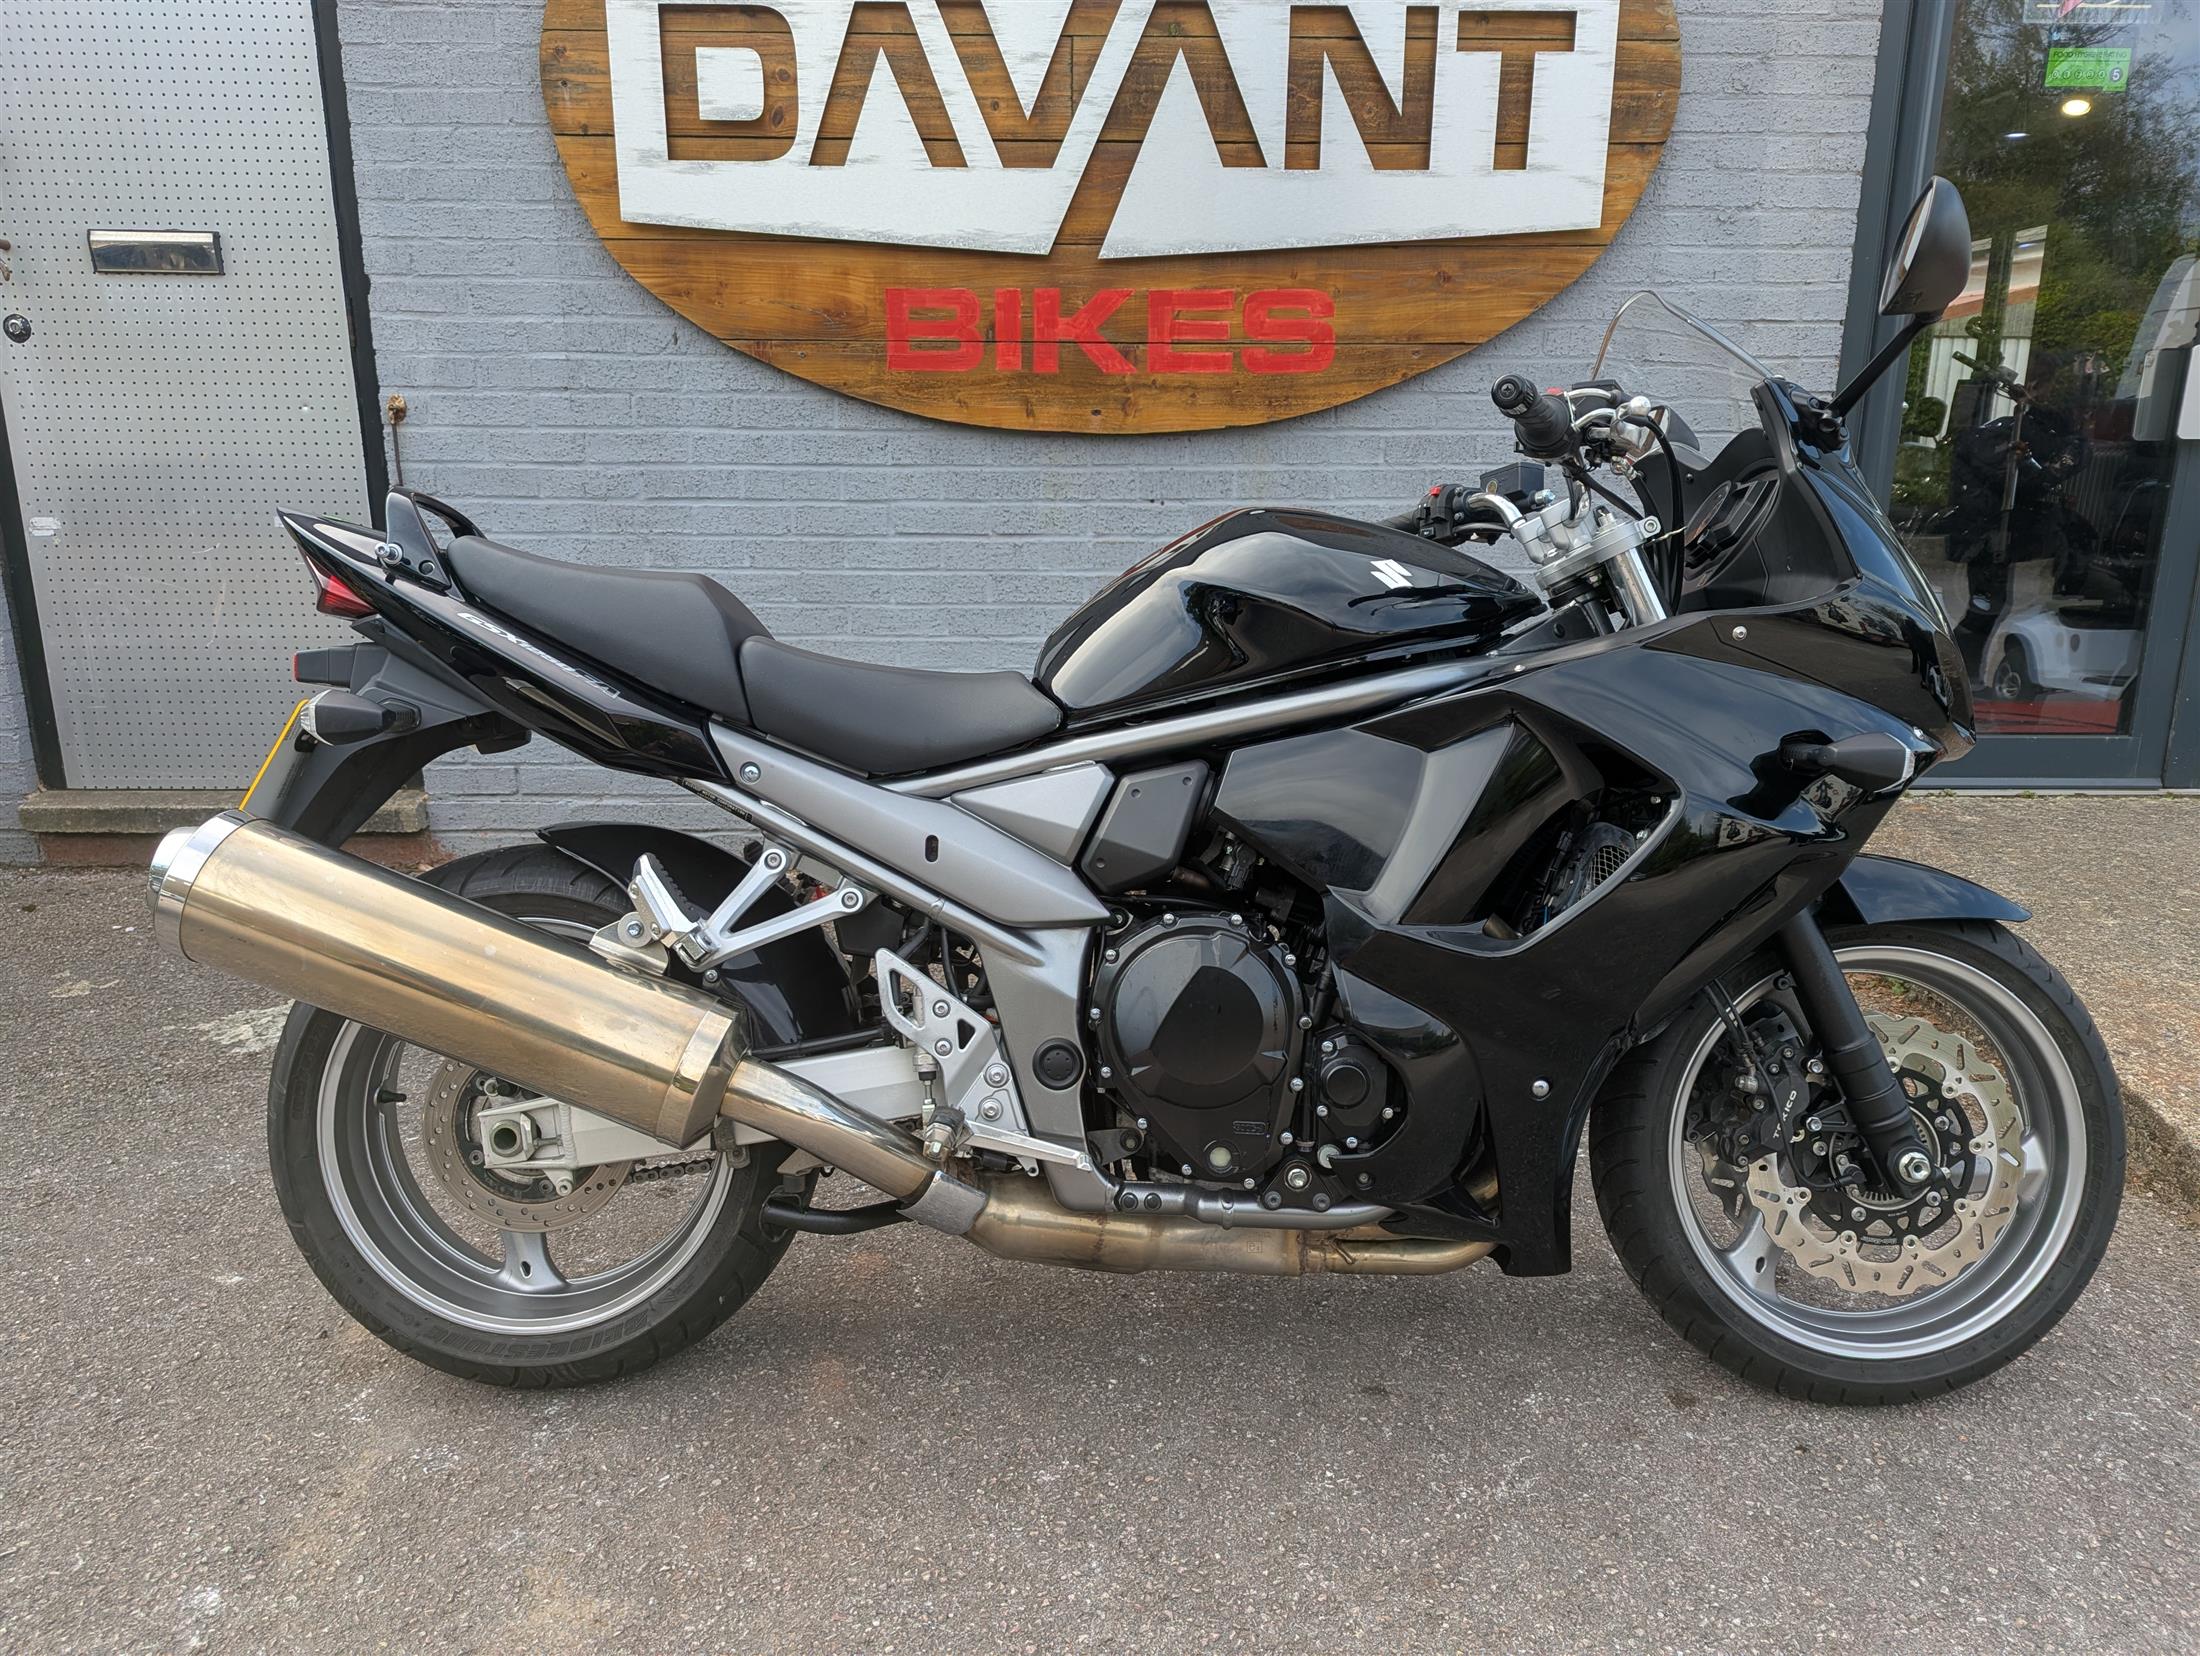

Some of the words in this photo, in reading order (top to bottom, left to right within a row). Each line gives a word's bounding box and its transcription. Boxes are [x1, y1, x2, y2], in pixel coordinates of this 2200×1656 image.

[658, 0, 1578, 171] DAVANT
[2112, 69, 2121, 80] 5
[885, 287, 1336, 373] BIKES
